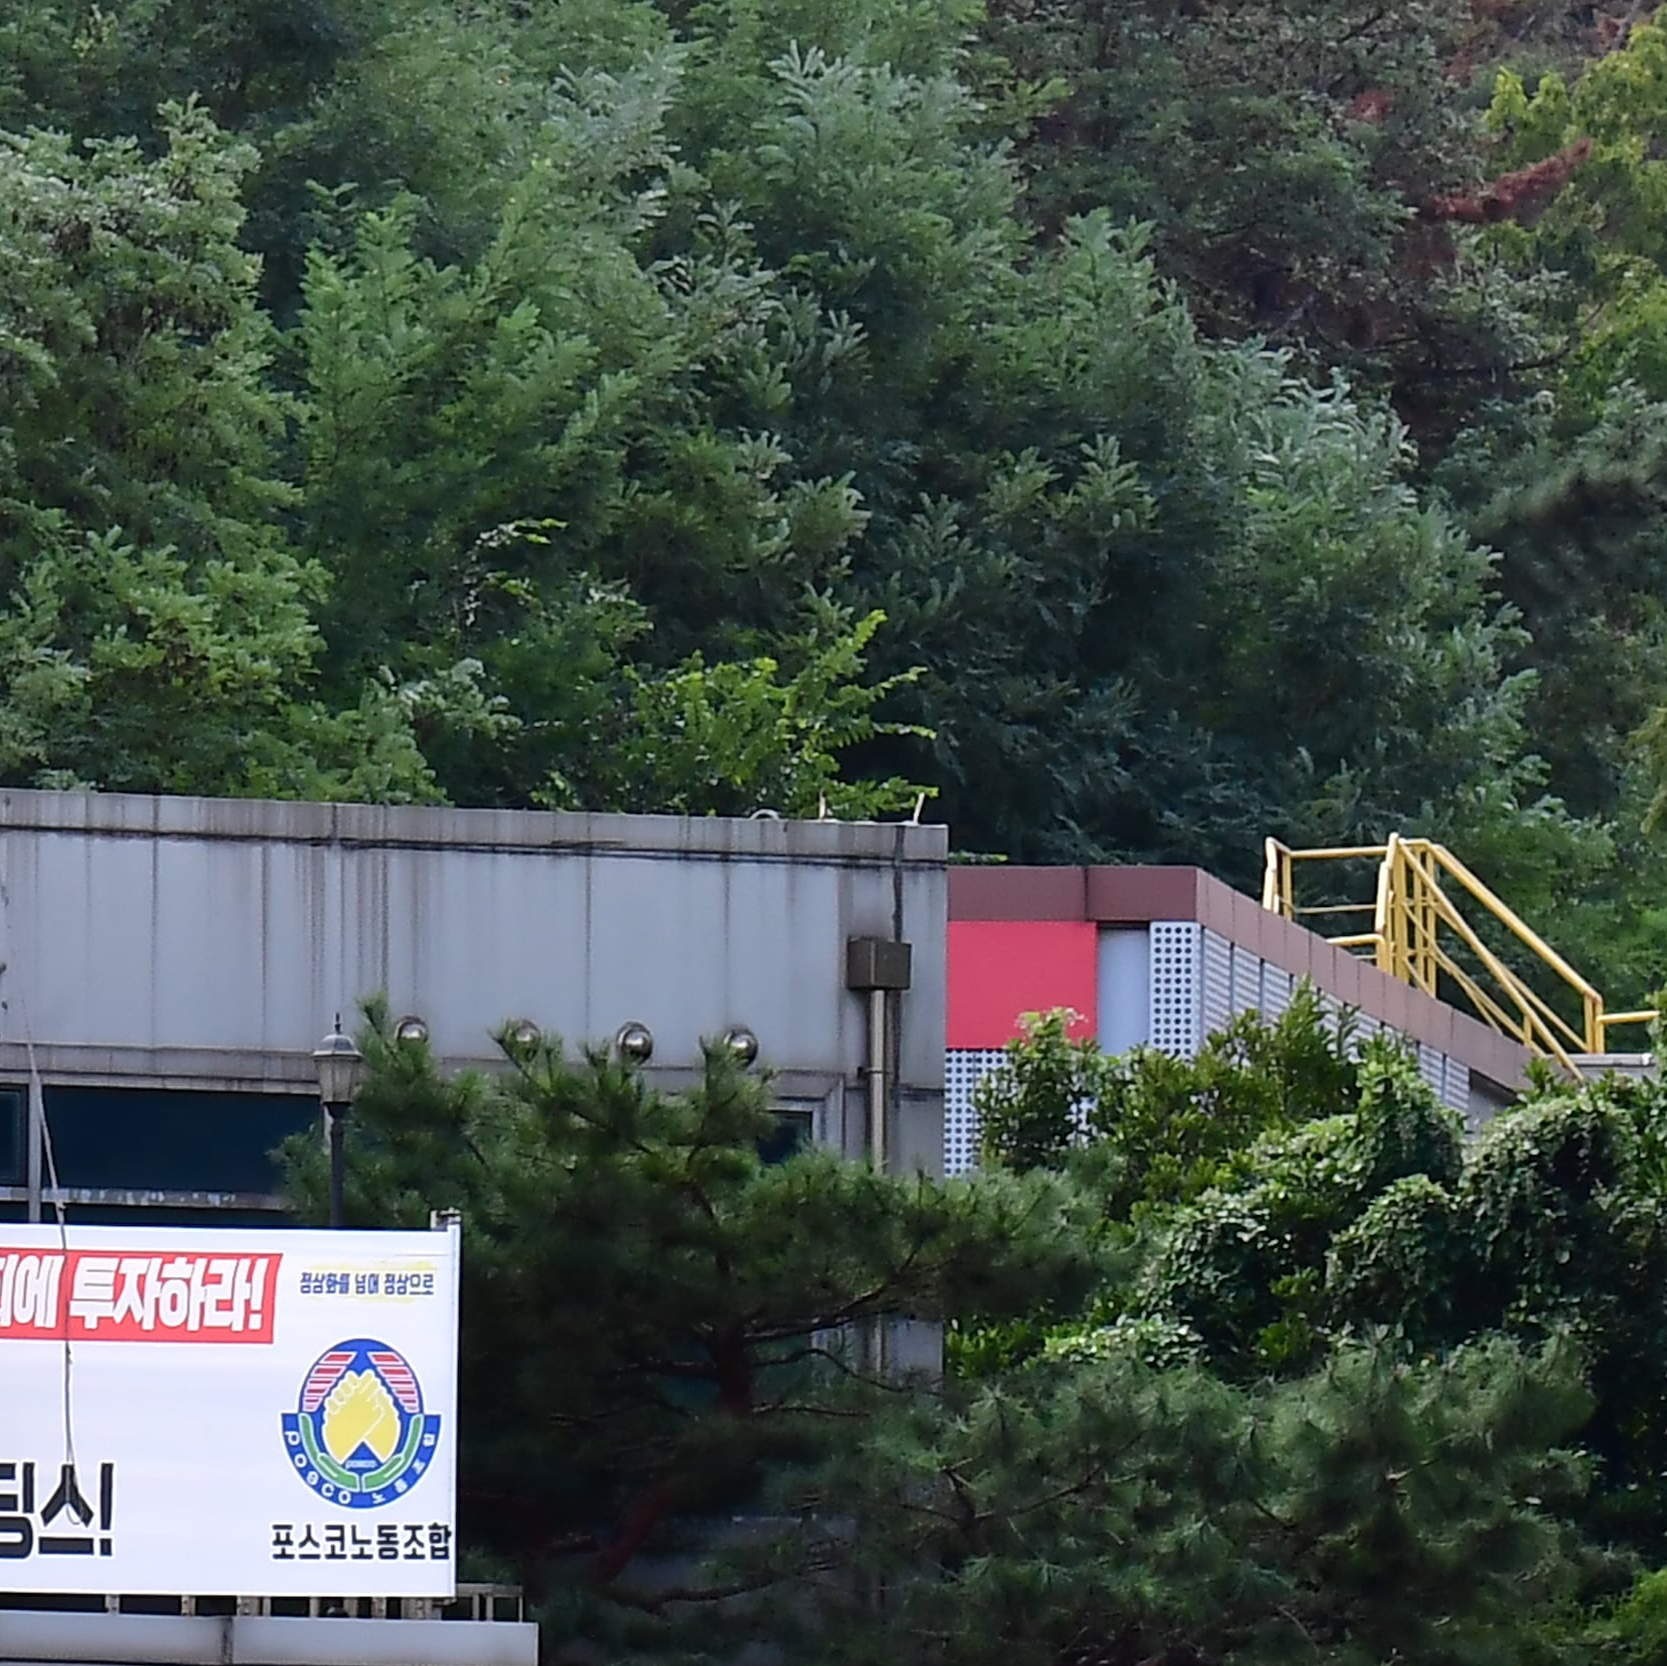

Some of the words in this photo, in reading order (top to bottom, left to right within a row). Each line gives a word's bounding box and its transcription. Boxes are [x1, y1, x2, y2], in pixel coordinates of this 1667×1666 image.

[69, 1256, 269, 1332] 투자하라!
[384, 1273, 435, 1296] 정상으로
[271, 1522, 452, 1560] 포스코노동조합
